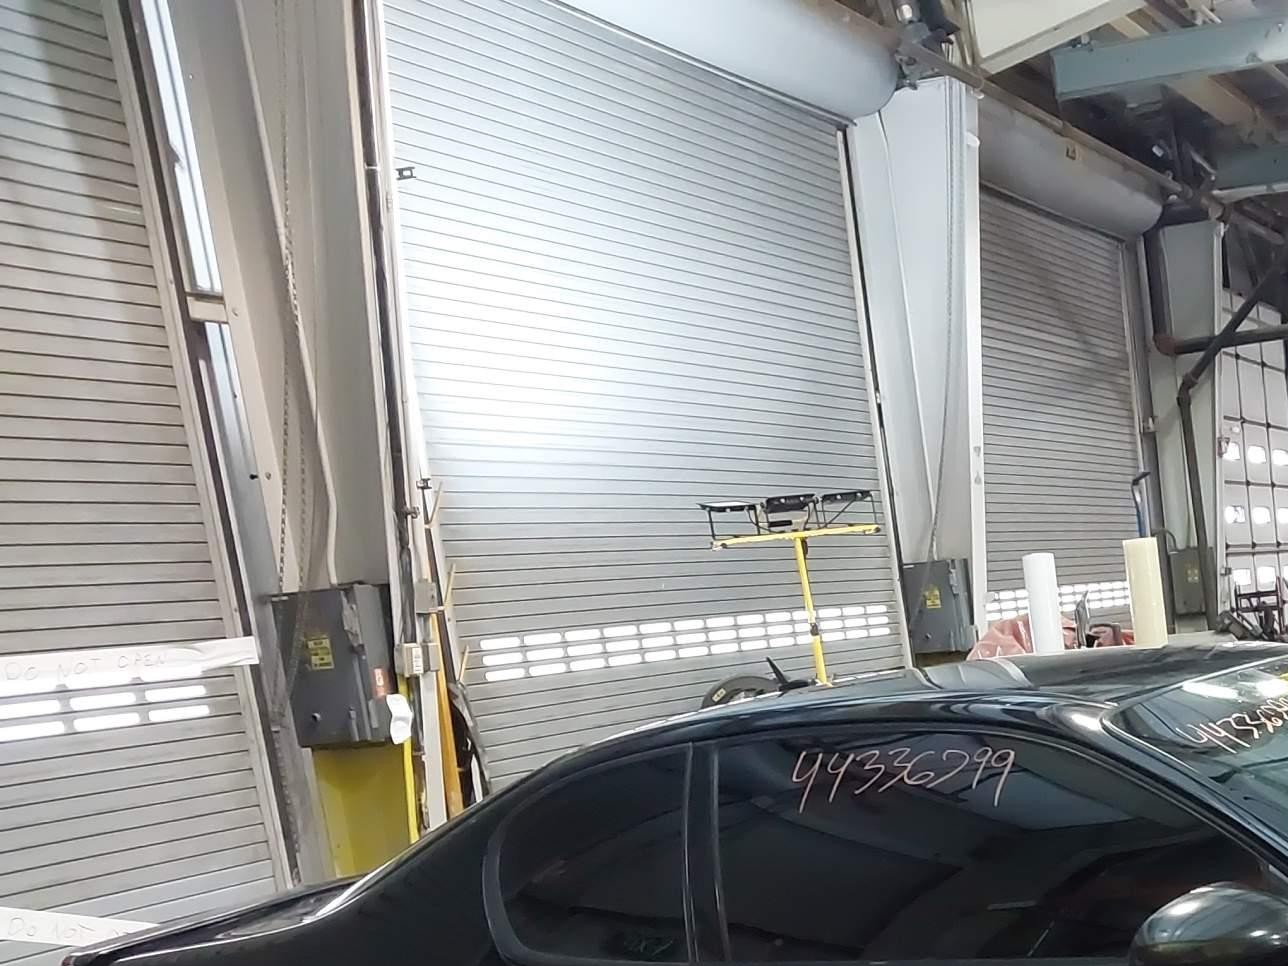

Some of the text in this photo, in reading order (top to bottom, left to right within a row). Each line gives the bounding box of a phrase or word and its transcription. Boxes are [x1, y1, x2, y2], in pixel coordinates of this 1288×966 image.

[56, 657, 105, 680] NOT
[117, 650, 168, 669] OPEN
[791, 746, 1016, 814] 44336799
